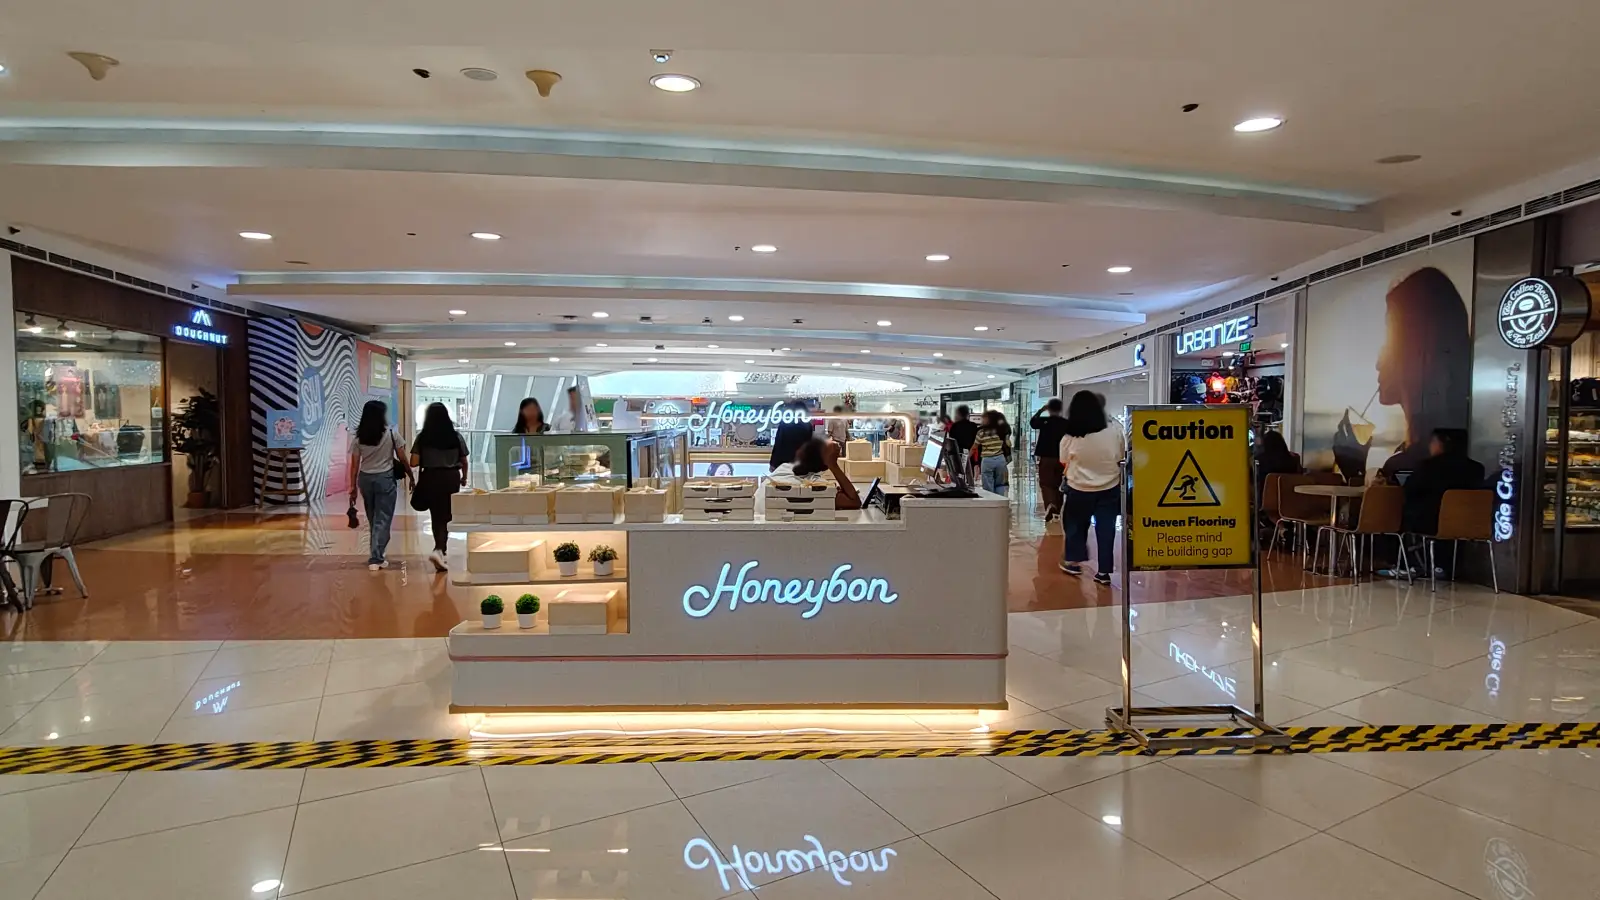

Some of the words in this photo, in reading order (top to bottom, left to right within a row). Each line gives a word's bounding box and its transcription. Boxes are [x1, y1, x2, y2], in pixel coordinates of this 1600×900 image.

[1502, 300, 1513, 316] The
[1509, 283, 1535, 301] Coffee
[174, 325, 228, 344] DOUGHNUT
[1176, 315, 1250, 355] URBANIZE
[1512, 333, 1526, 344] Tea
[687, 400, 812, 433] Honeybon
[1142, 419, 1234, 440] Caution
[1142, 517, 1186, 528] Uneven
[1188, 516, 1236, 528] Flooring
[1494, 503, 1513, 542] The
[1157, 532, 1193, 543] Please
[1195, 532, 1223, 542] mind
[1147, 547, 1164, 557] the
[1167, 546, 1209, 558] building
[1211, 547, 1233, 558] gap
[682, 560, 898, 618] Honeybon
